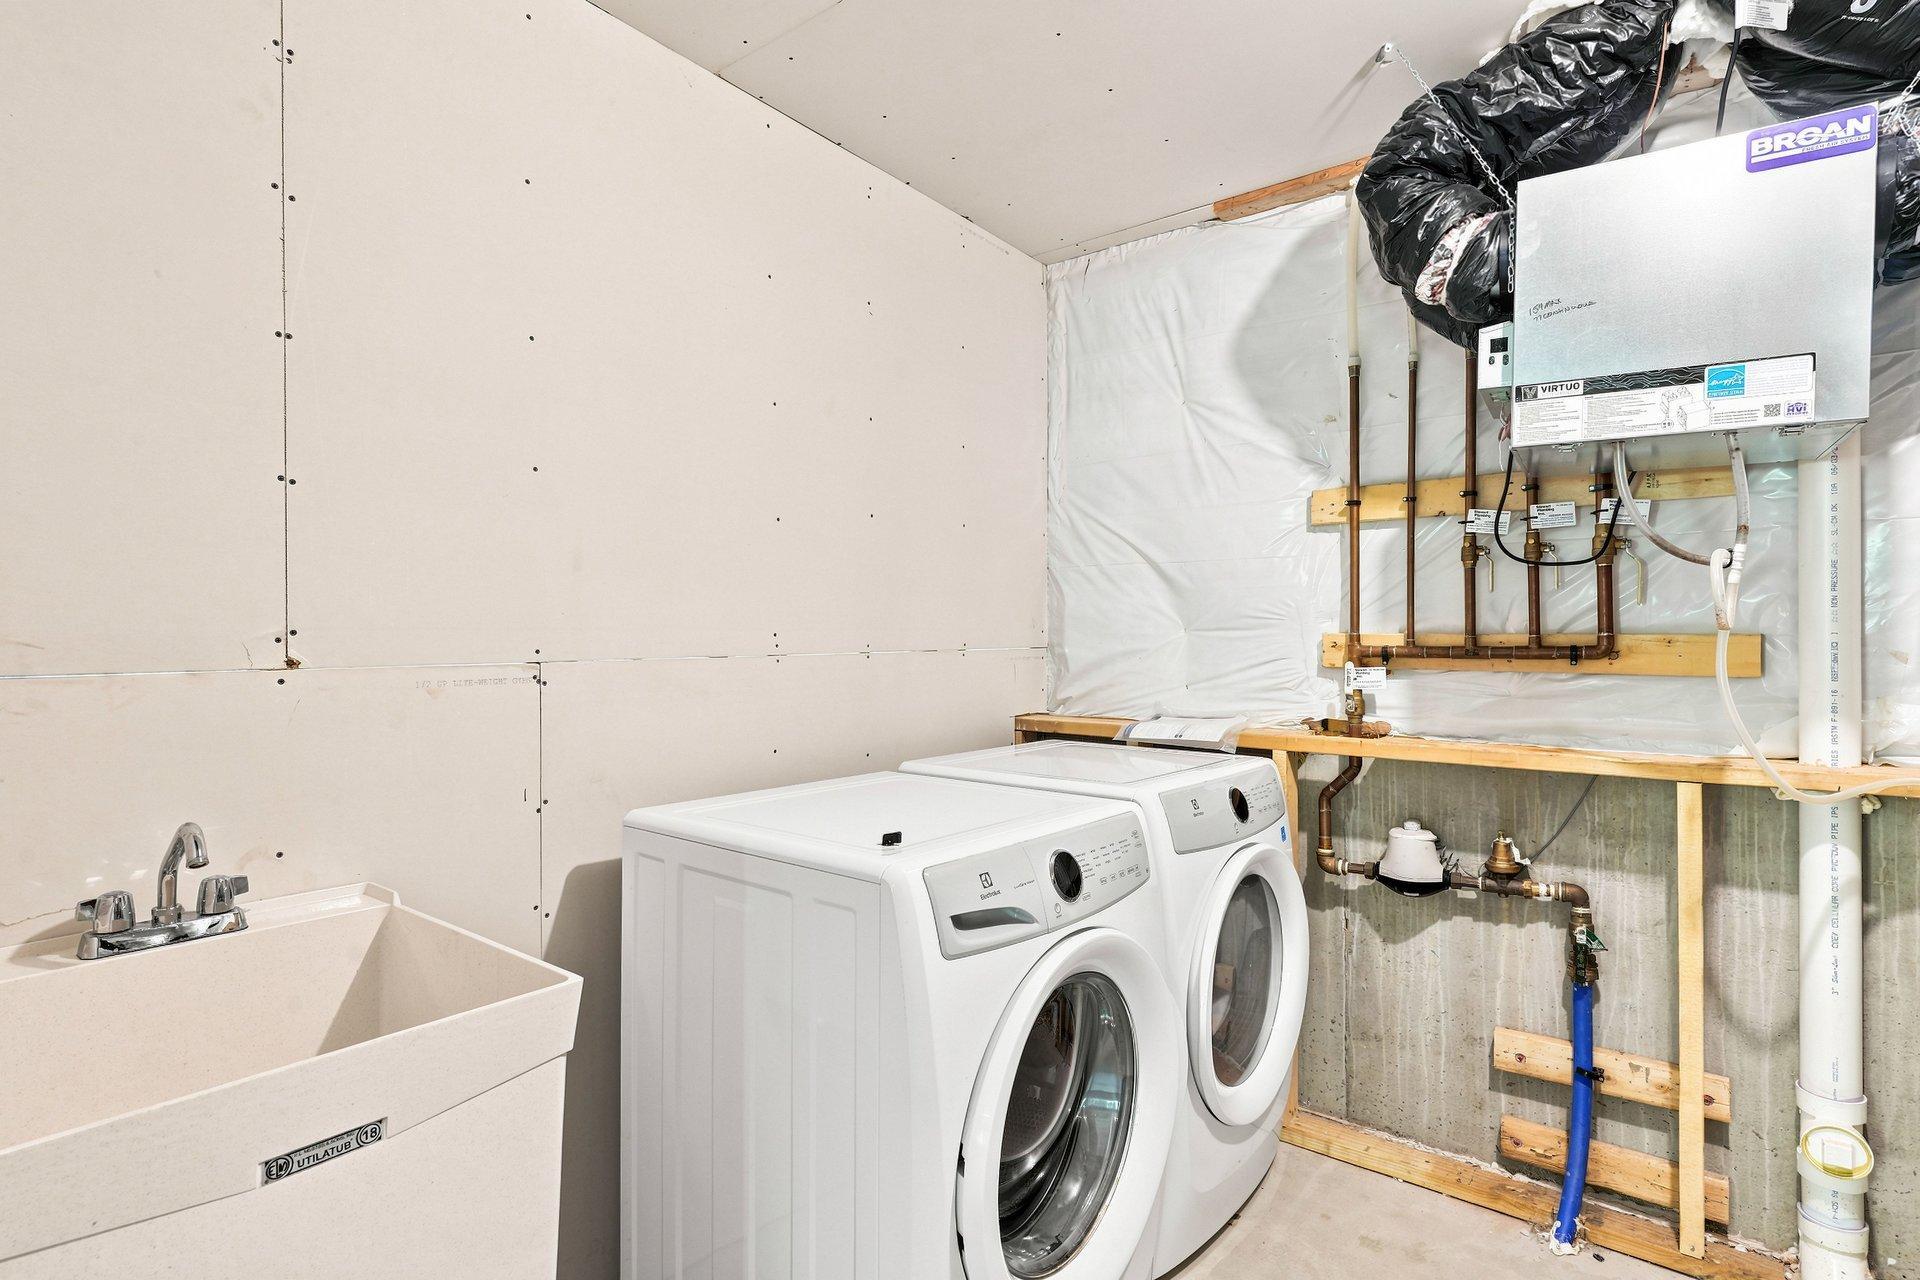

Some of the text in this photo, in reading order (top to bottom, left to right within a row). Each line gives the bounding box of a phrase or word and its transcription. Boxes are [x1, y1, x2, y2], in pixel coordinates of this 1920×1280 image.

[1751, 114, 1871, 157] BROAN
[1541, 382, 1580, 394] VIRTUO
[1831, 559, 1839, 592] PRESSURE
[1831, 822, 1839, 840] PIPE
[980, 889, 1001, 901] Electrolux
[297, 1141, 352, 1168] UTILATUB
[362, 1127, 378, 1141] 18
